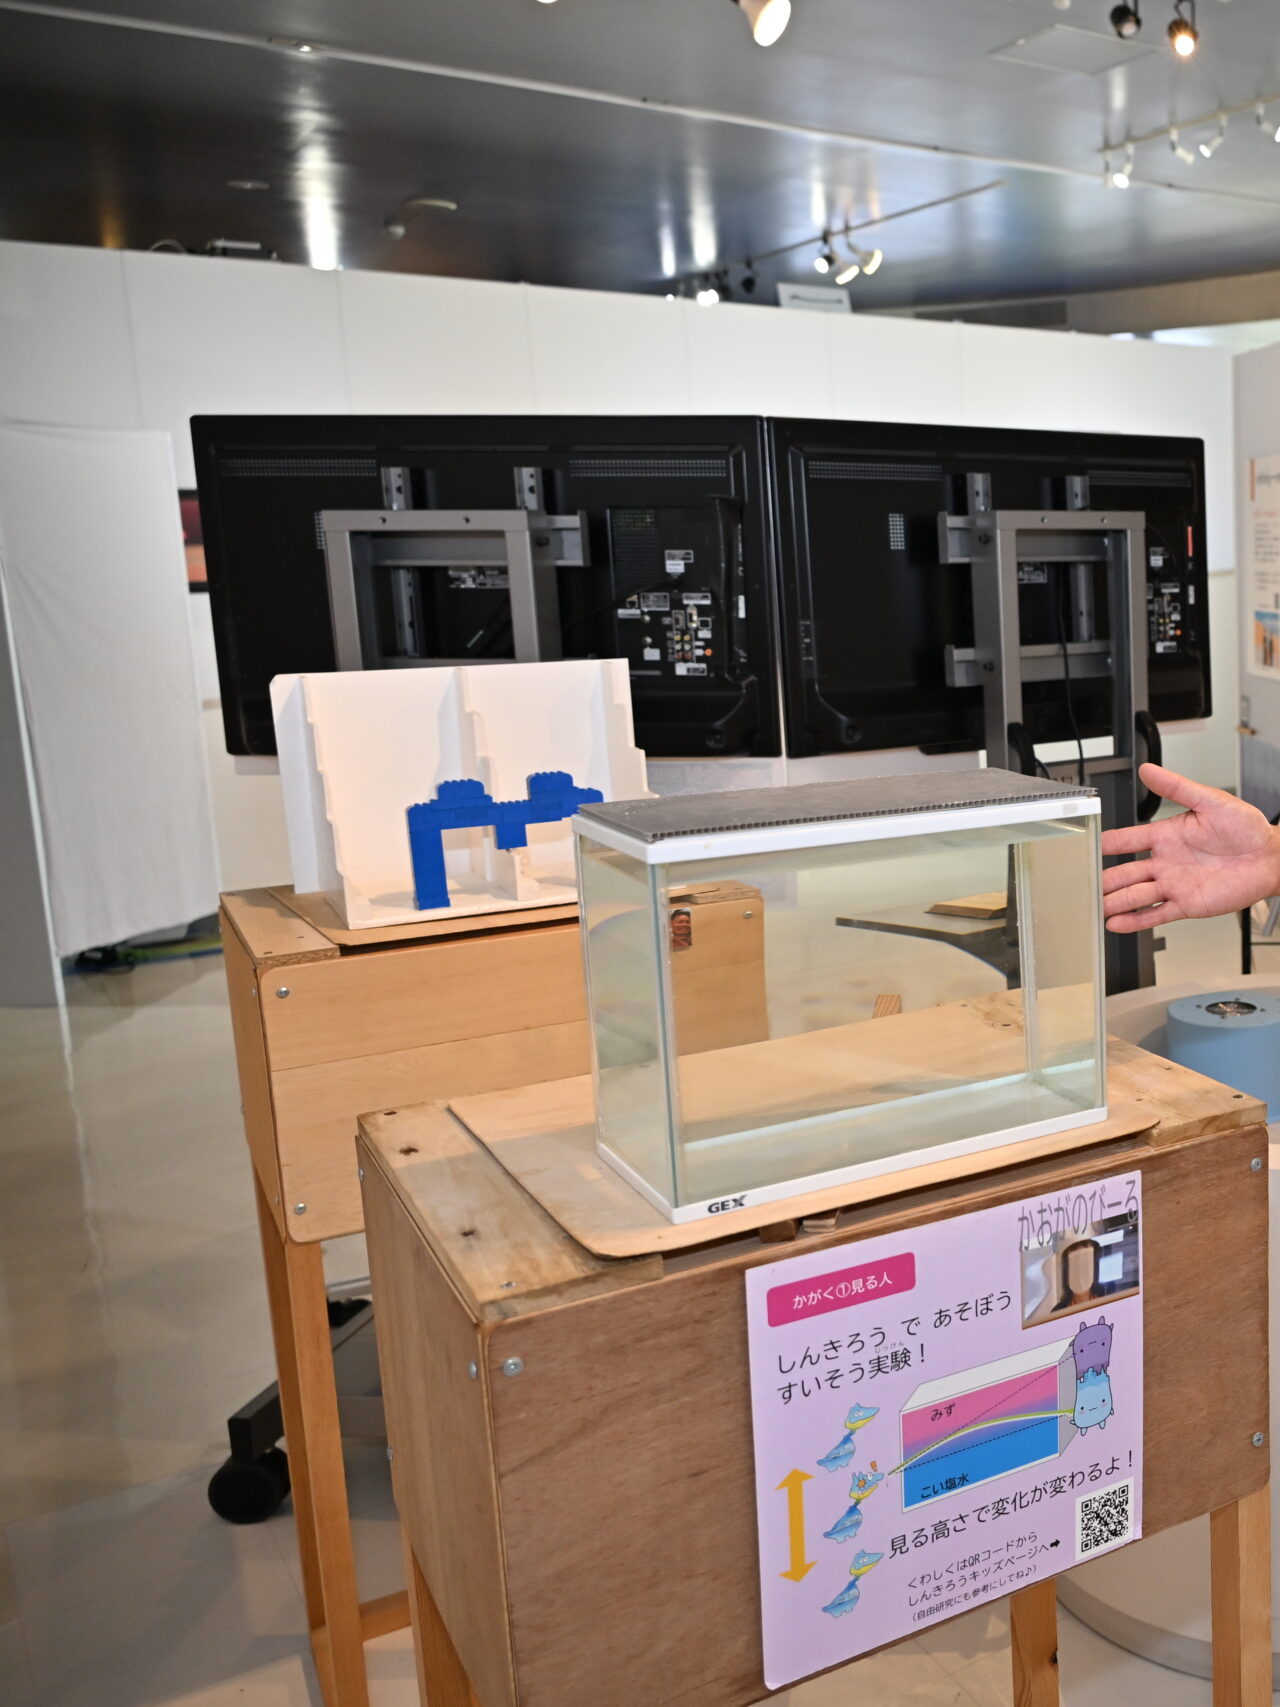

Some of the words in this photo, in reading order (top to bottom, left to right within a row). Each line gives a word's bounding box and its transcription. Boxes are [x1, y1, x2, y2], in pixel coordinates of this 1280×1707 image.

[707, 1194, 747, 1214] GEX
[792, 1271, 893, 1310] かがく①見る人
[777, 1326, 886, 1375] しんきろう
[901, 1316, 921, 1336] で
[932, 1290, 1012, 1329] あそぼう
[930, 1402, 956, 1422] みず
[920, 1472, 970, 1500] こい塩水
[907, 1531, 1039, 1590] くわしくはQRコードから
